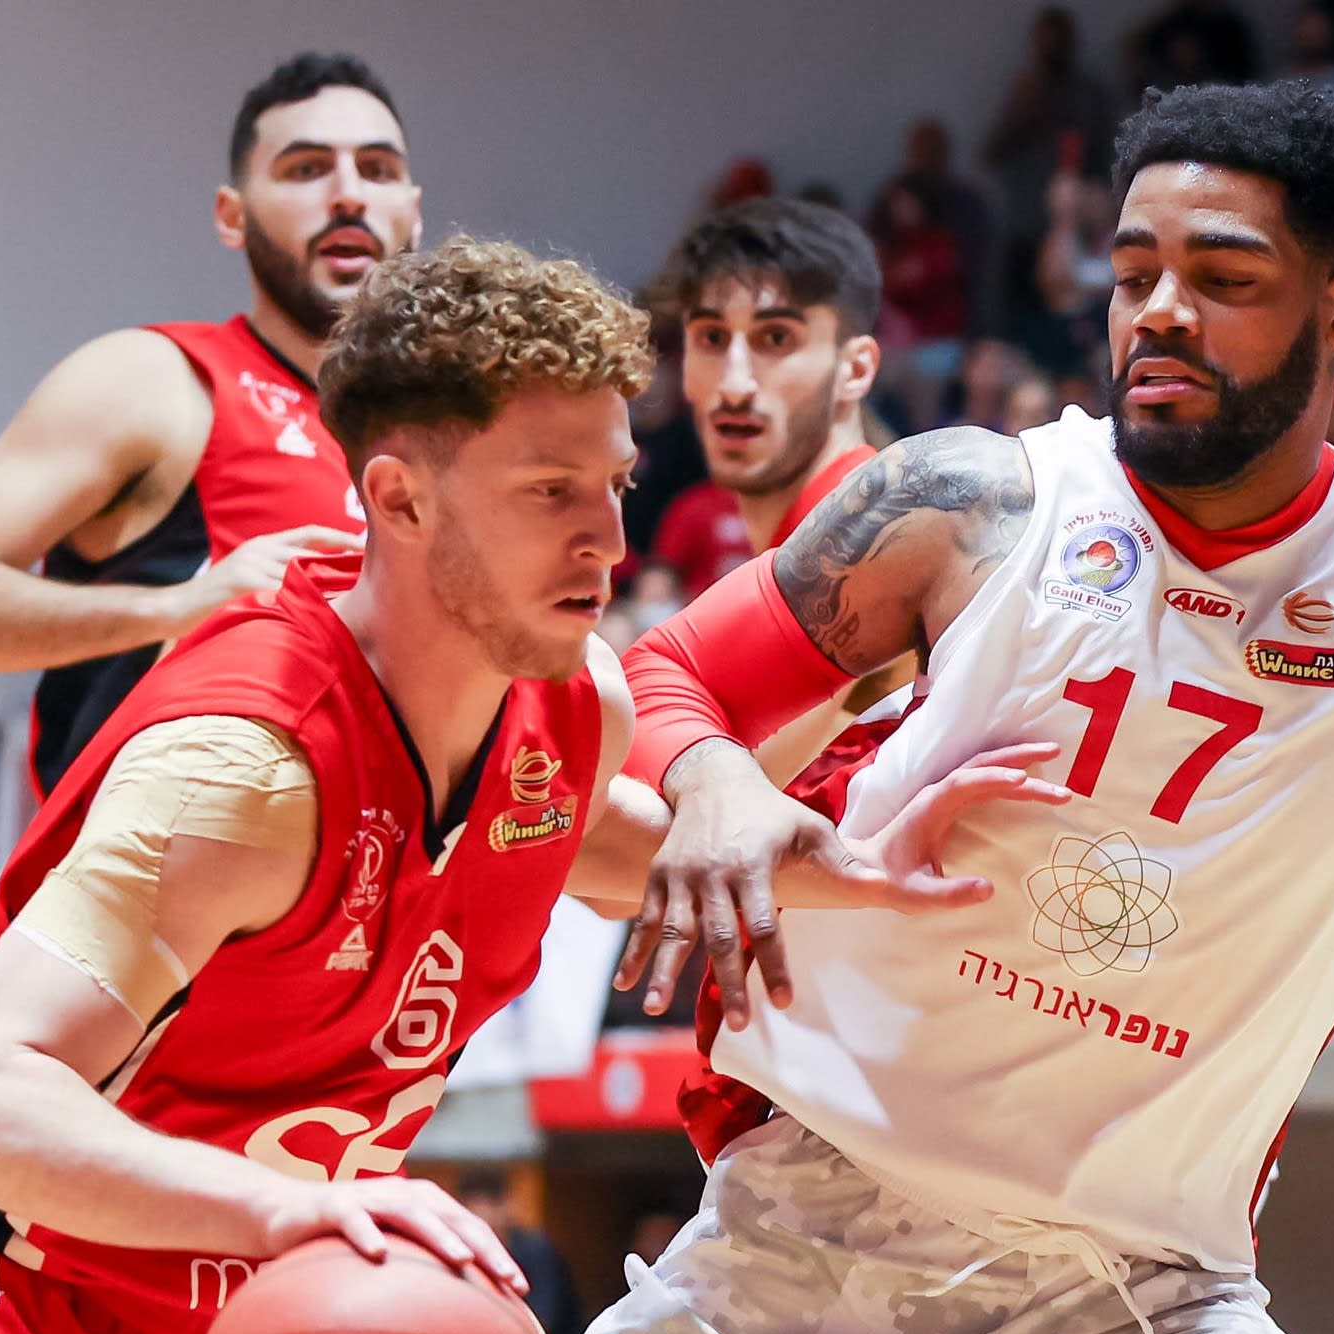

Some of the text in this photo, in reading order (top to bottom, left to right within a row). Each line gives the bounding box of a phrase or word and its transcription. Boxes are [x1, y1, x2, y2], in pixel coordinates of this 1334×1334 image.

[1050, 585, 1083, 602] Galil
[1086, 595, 1123, 613] Elion
[1170, 592, 1246, 625] AND 1
[1062, 666, 1264, 824] 17
[370, 929, 464, 1070] 6
